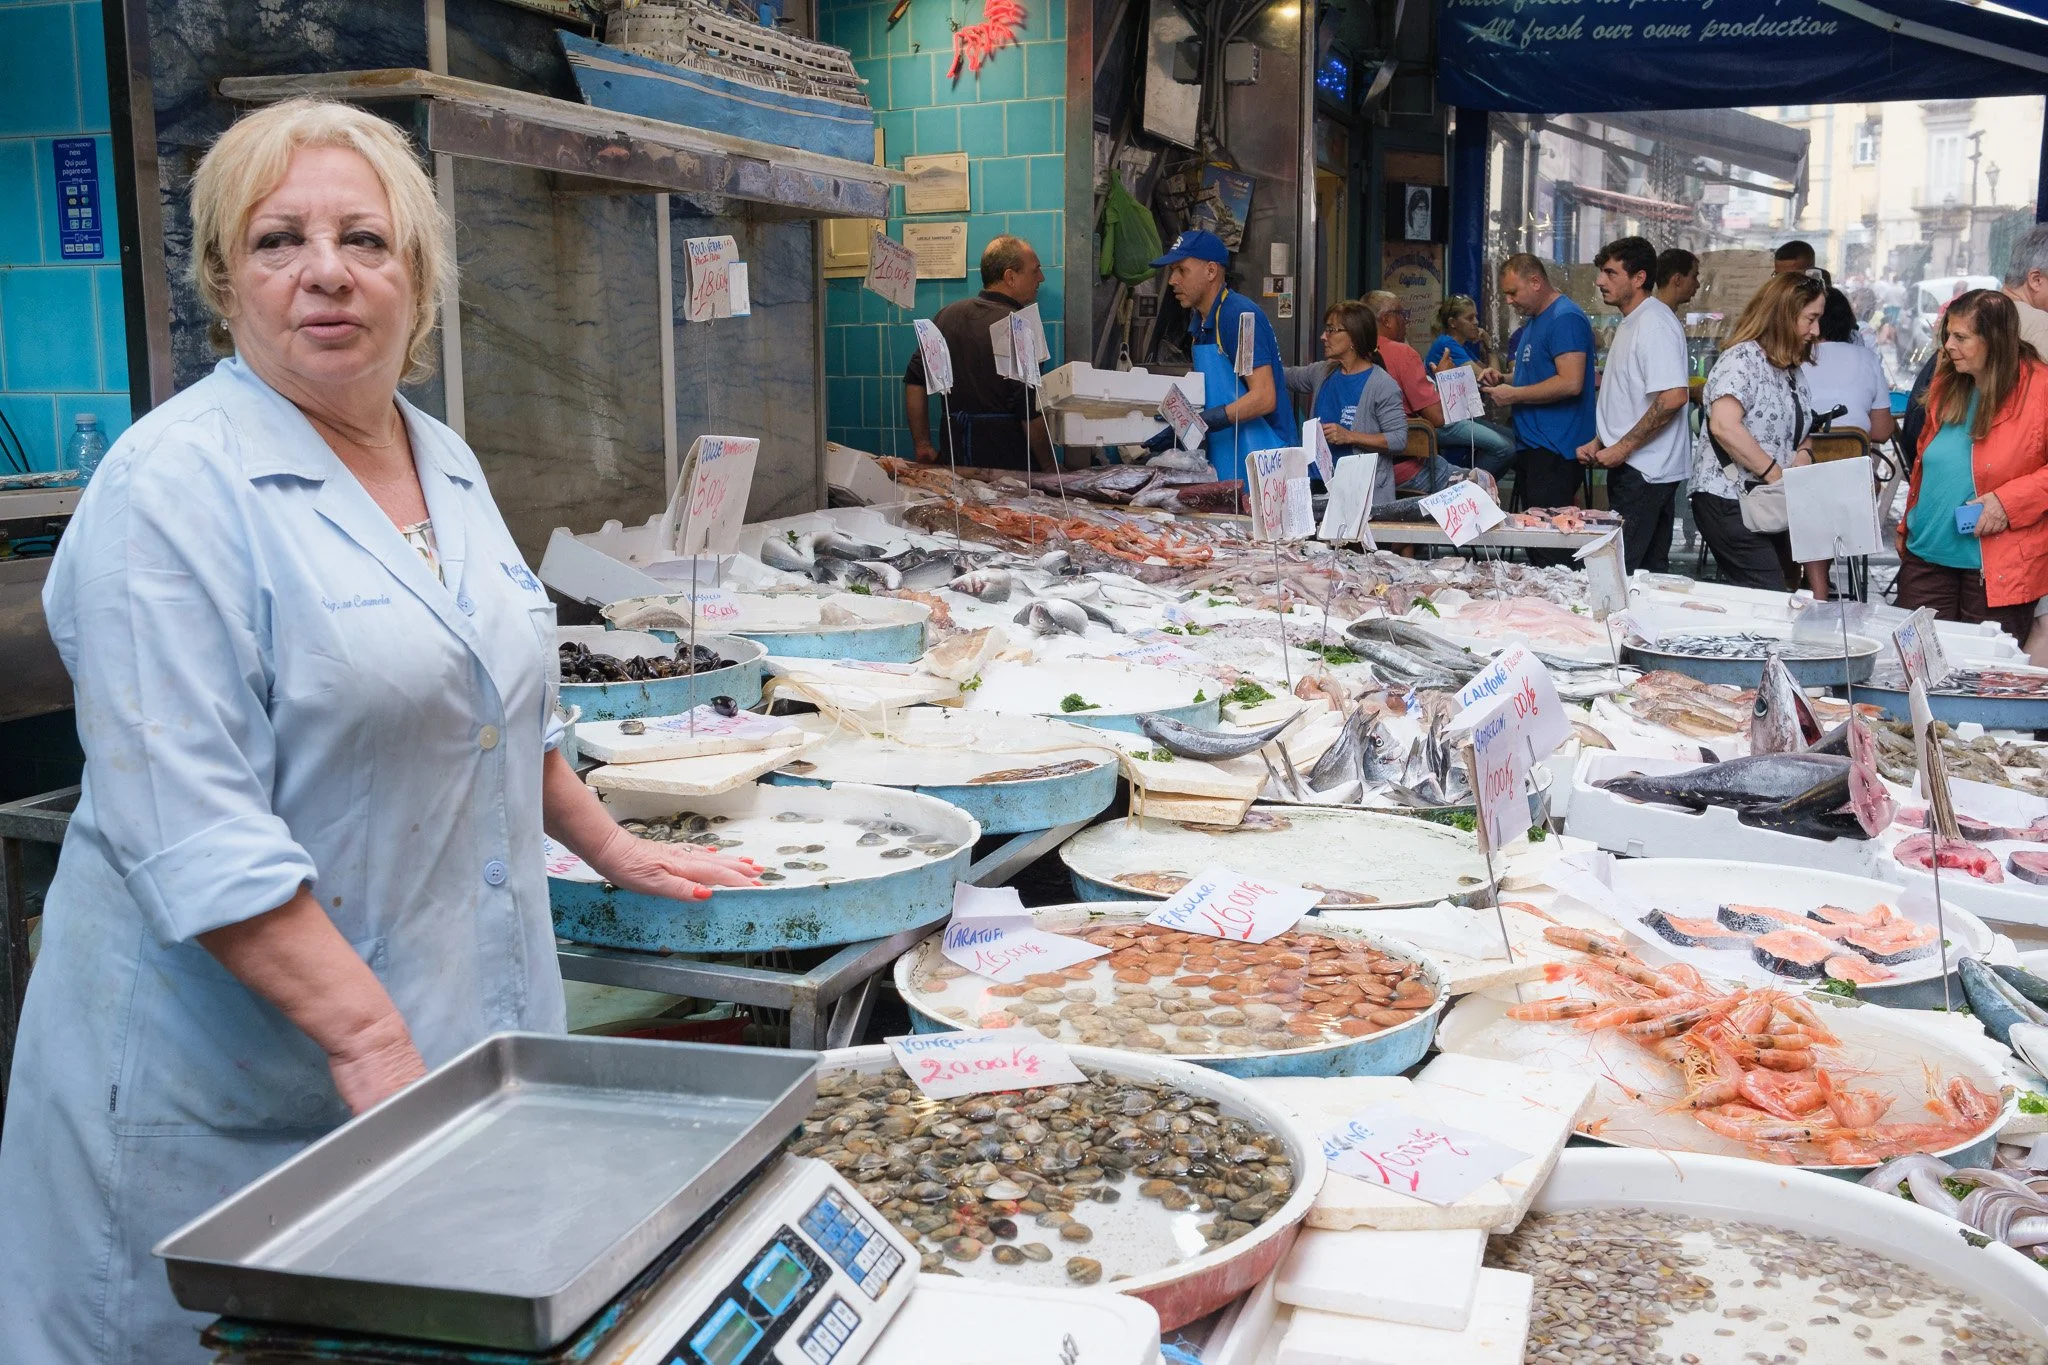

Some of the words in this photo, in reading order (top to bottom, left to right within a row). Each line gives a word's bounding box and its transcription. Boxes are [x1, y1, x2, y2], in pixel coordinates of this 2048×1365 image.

[1469, 17, 1512, 43] All
[1520, 15, 1585, 49] fresh
[1593, 24, 1633, 40] our
[1643, 21, 1691, 38] own
[1699, 14, 1838, 42] production
[62, 168, 80, 176] pagare
